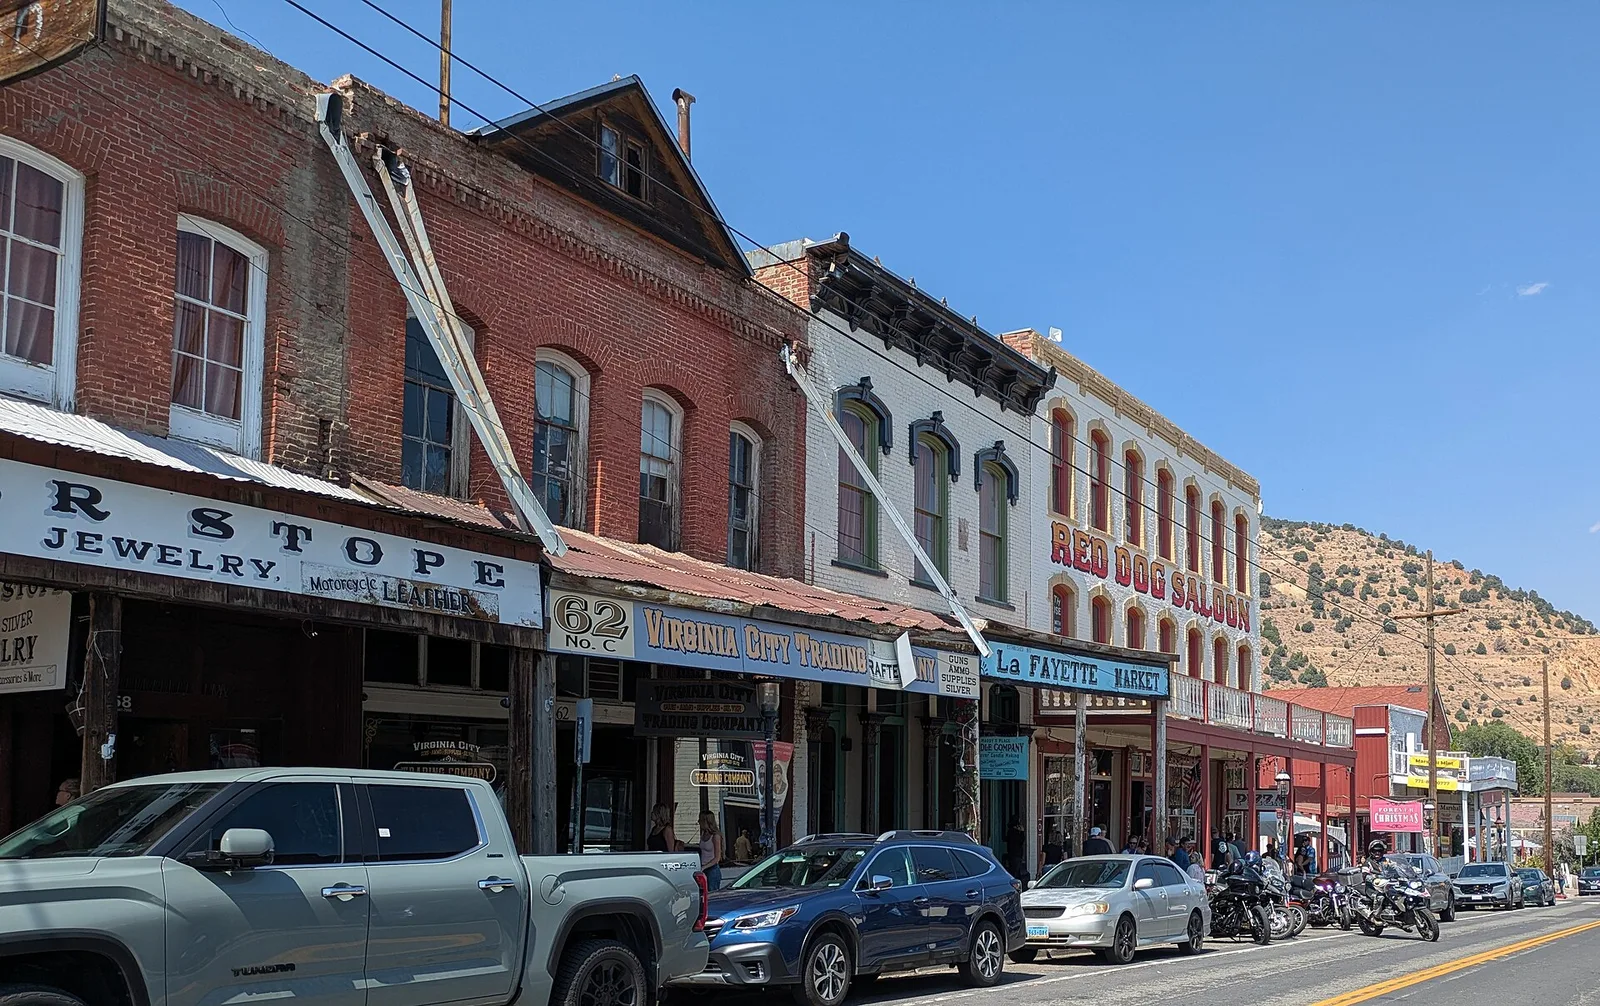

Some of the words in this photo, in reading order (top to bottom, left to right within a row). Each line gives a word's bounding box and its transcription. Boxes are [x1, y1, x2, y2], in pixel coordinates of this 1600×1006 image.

[188, 507, 505, 588] STOPE
[41, 527, 281, 583] JEWELRY,
[1051, 520, 1108, 579] RED
[1114, 545, 1165, 600] DOG
[1171, 571, 1250, 633] SALOON
[1, 609, 34, 633] SILVER
[553, 594, 630, 640] 62
[565, 634, 597, 650] No.
[602, 639, 617, 652] C
[643, 607, 740, 659] VIRGINIA
[744, 624, 791, 665] CITY
[794, 632, 868, 675] TRADING
[948, 654, 969, 666] GUNS
[948, 665, 970, 676] AMMO
[996, 649, 1020, 675] La
[1029, 654, 1098, 685] FAYETTE
[1114, 668, 1160, 691] MARKET
[941, 674, 977, 686] SUPPLIES
[945, 684, 971, 695] SILVER
[556, 705, 569, 720] 62
[413, 741, 456, 751] VIRGINIA
[458, 740, 481, 752] CITY
[994, 743, 1025, 753] COMPANY
[702, 752, 729, 761] VIRGINIA
[730, 752, 744, 762] CITY
[695, 772, 722, 783] TRADING
[724, 773, 752, 784] COMPANY
[1235, 793, 1286, 807] PZZA
[1374, 812, 1419, 824] CHRISTMAS
